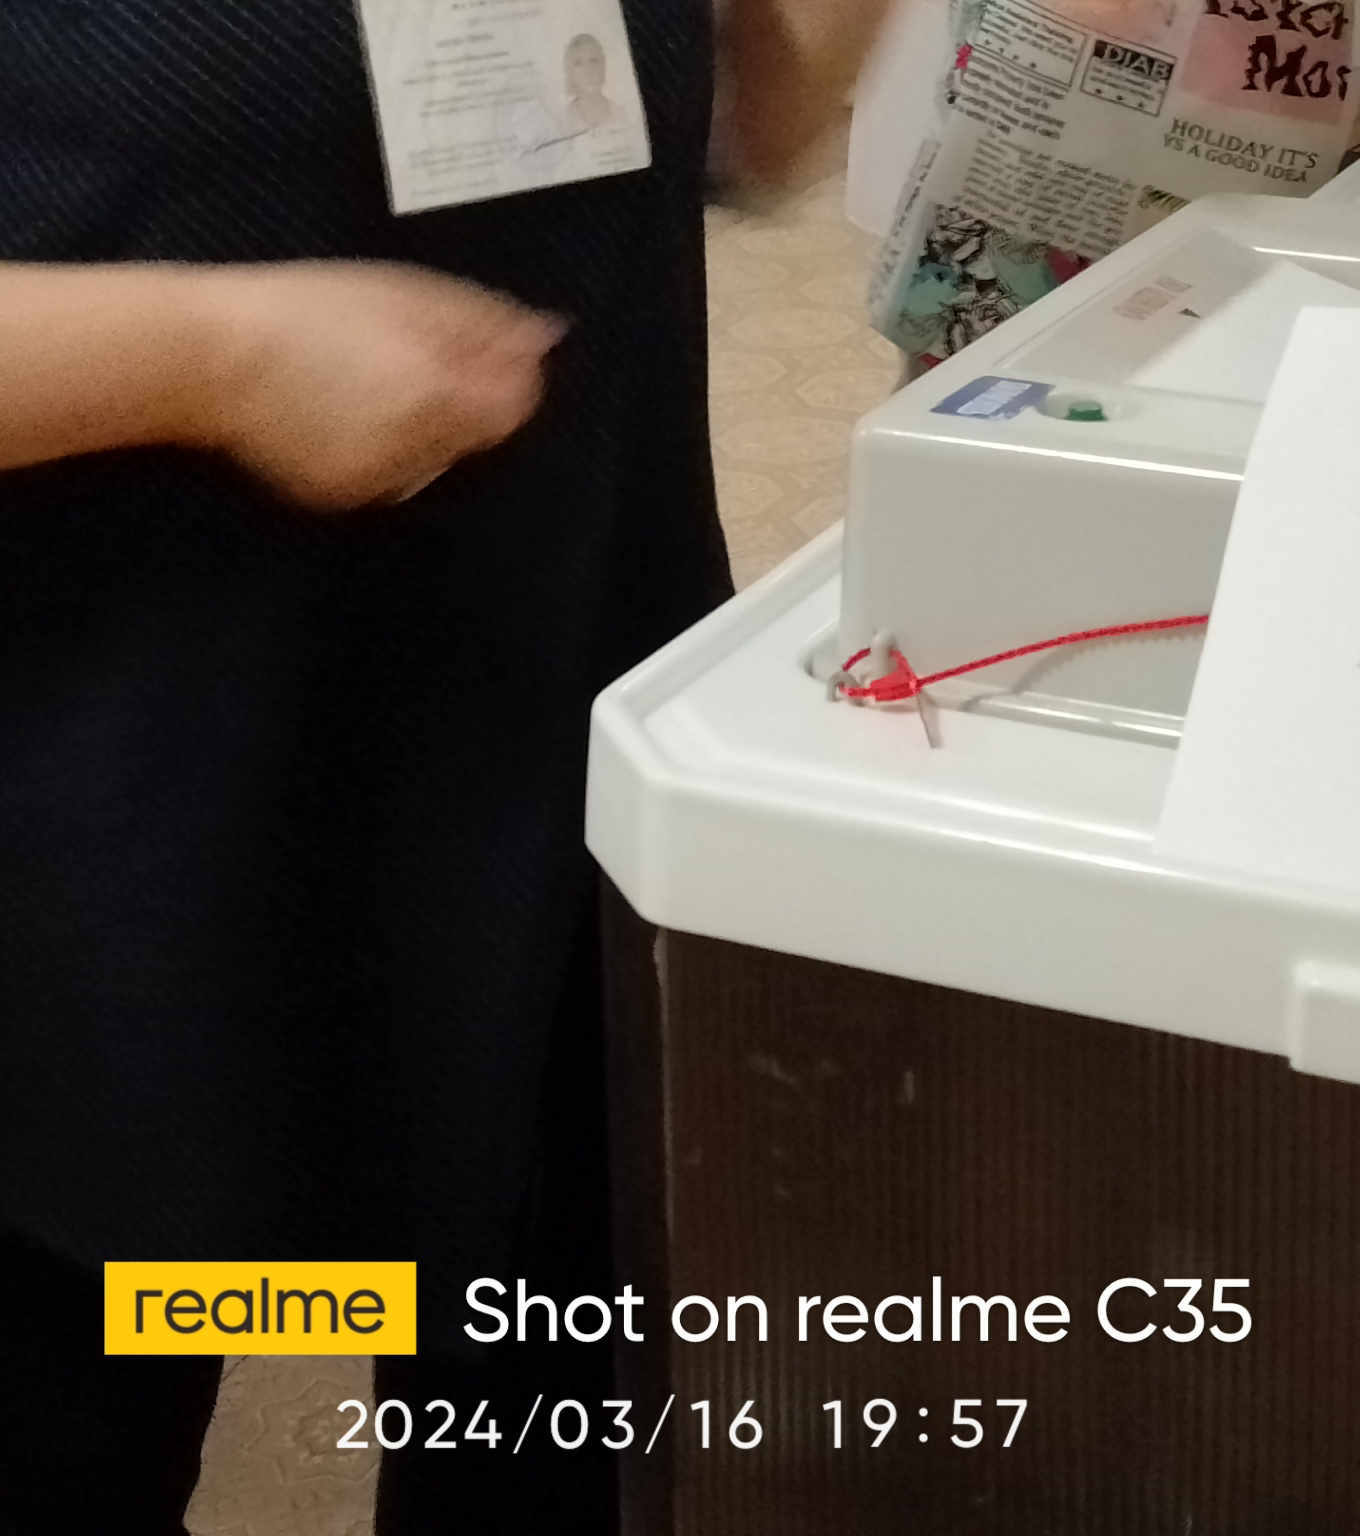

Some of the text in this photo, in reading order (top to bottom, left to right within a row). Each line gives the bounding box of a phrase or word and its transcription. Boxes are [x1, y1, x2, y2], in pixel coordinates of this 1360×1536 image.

[1172, 118, 1274, 159] HOLIDAY
[1187, 145, 1201, 158] A
[1205, 148, 1259, 173] GOOD
[1263, 164, 1308, 183] IDEA
